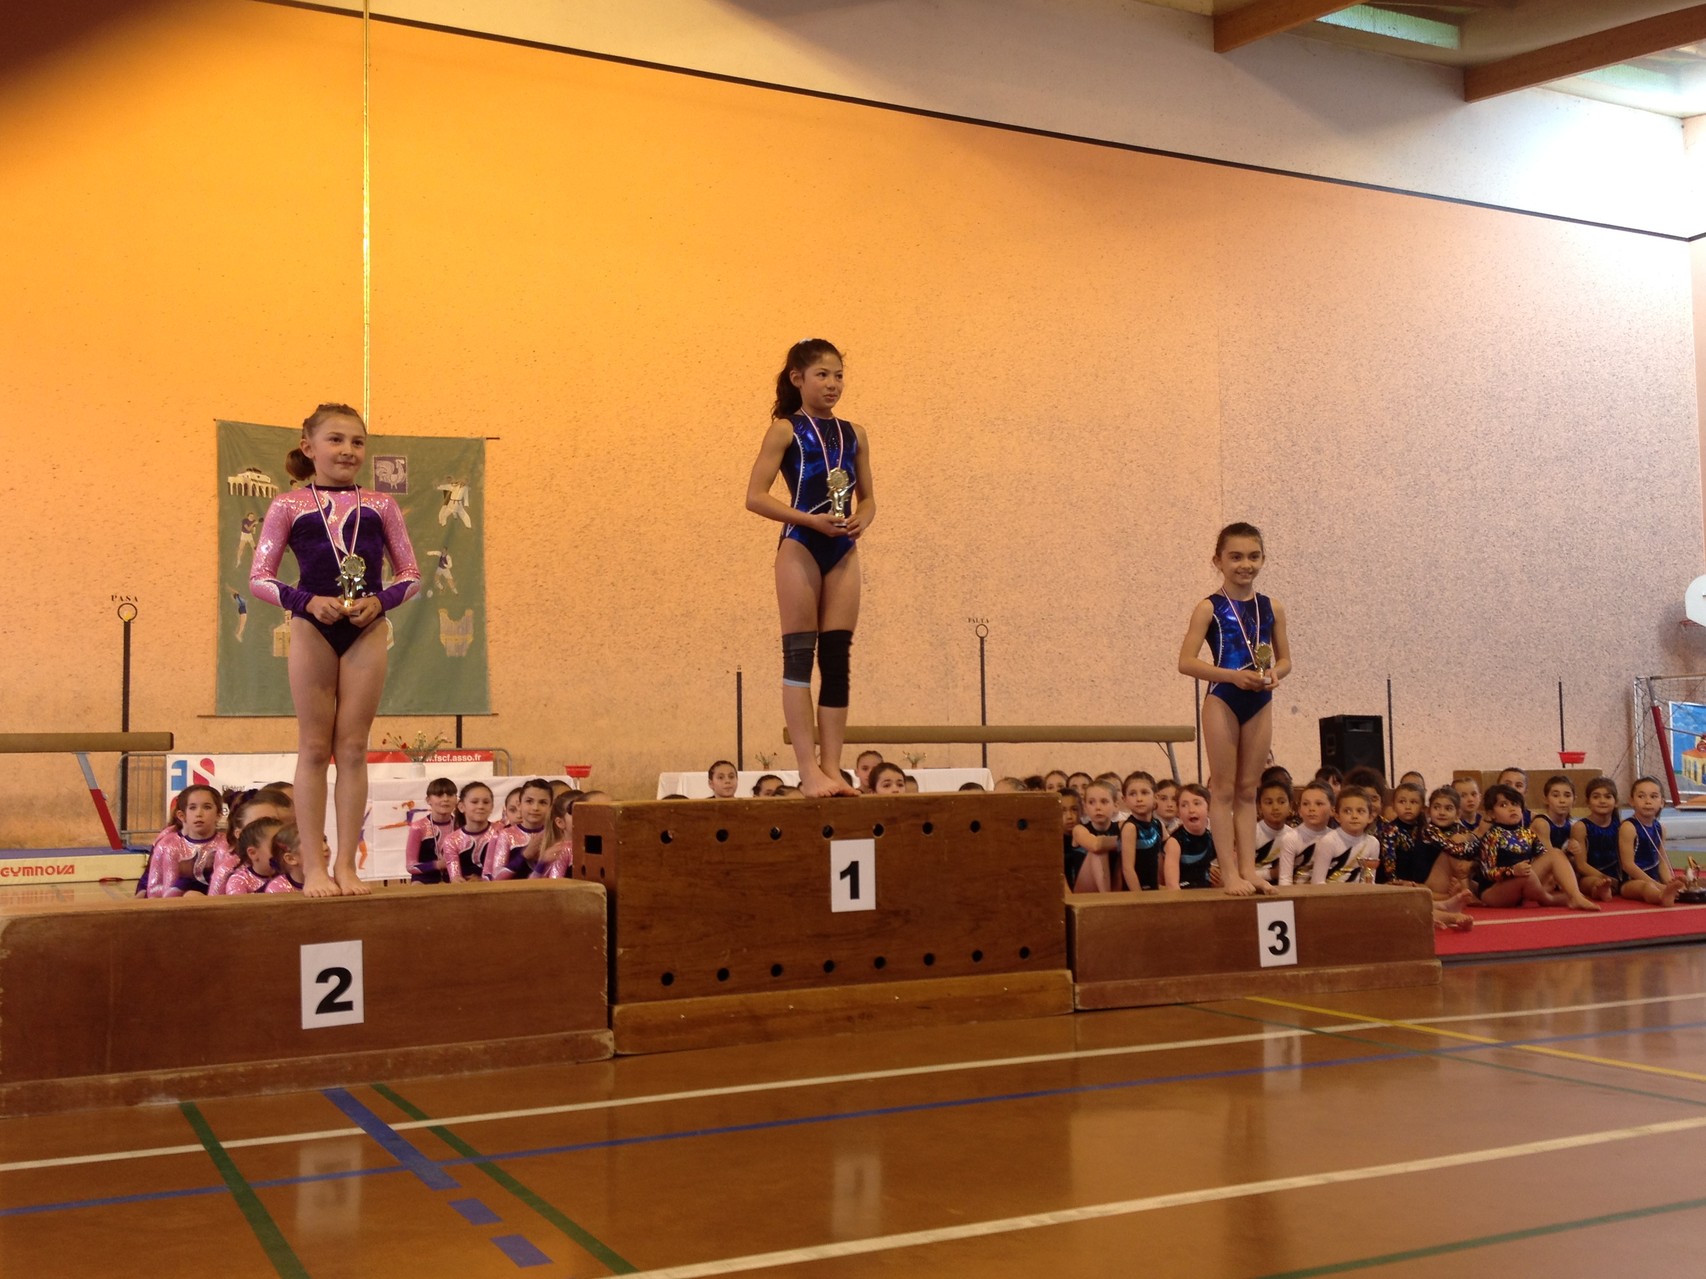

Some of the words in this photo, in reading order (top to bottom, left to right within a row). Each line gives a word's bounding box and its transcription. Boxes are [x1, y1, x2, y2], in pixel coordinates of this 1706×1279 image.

[0, 864, 76, 878] GYMNOVA
[839, 860, 860, 900] 1
[1268, 920, 1291, 957] 3
[315, 966, 354, 1015] 2
